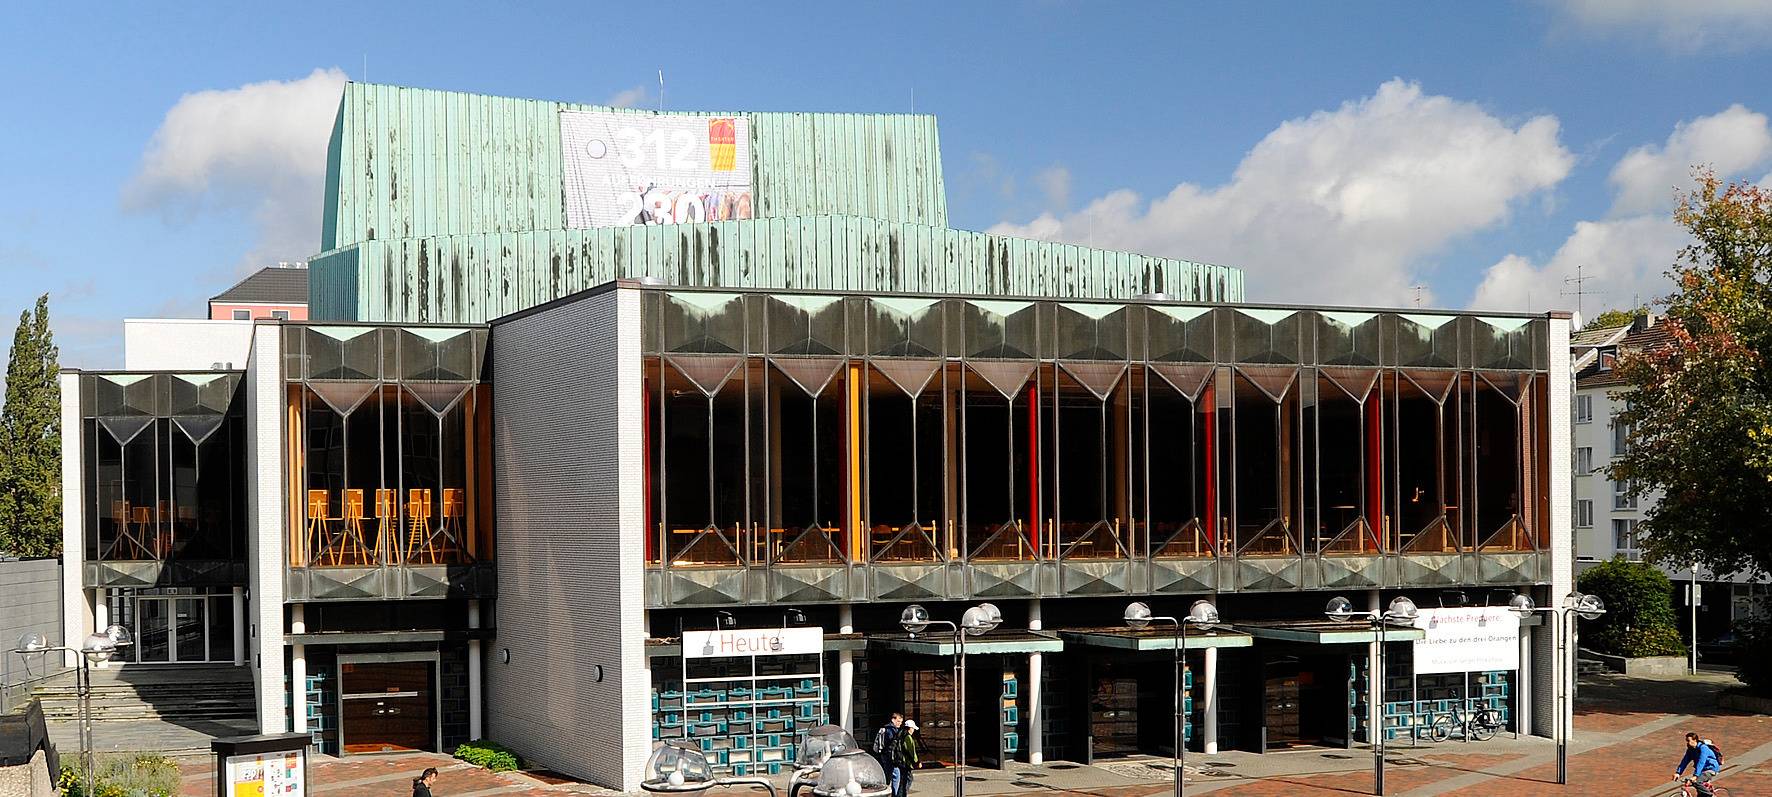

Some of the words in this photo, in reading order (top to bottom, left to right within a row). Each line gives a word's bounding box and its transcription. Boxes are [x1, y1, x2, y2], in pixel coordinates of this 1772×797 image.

[617, 127, 698, 168] 312
[616, 191, 705, 225] 230
[720, 633, 785, 652] Heute:
[1429, 637, 1448, 645] Liebe
[1488, 635, 1517, 643] Orangen
